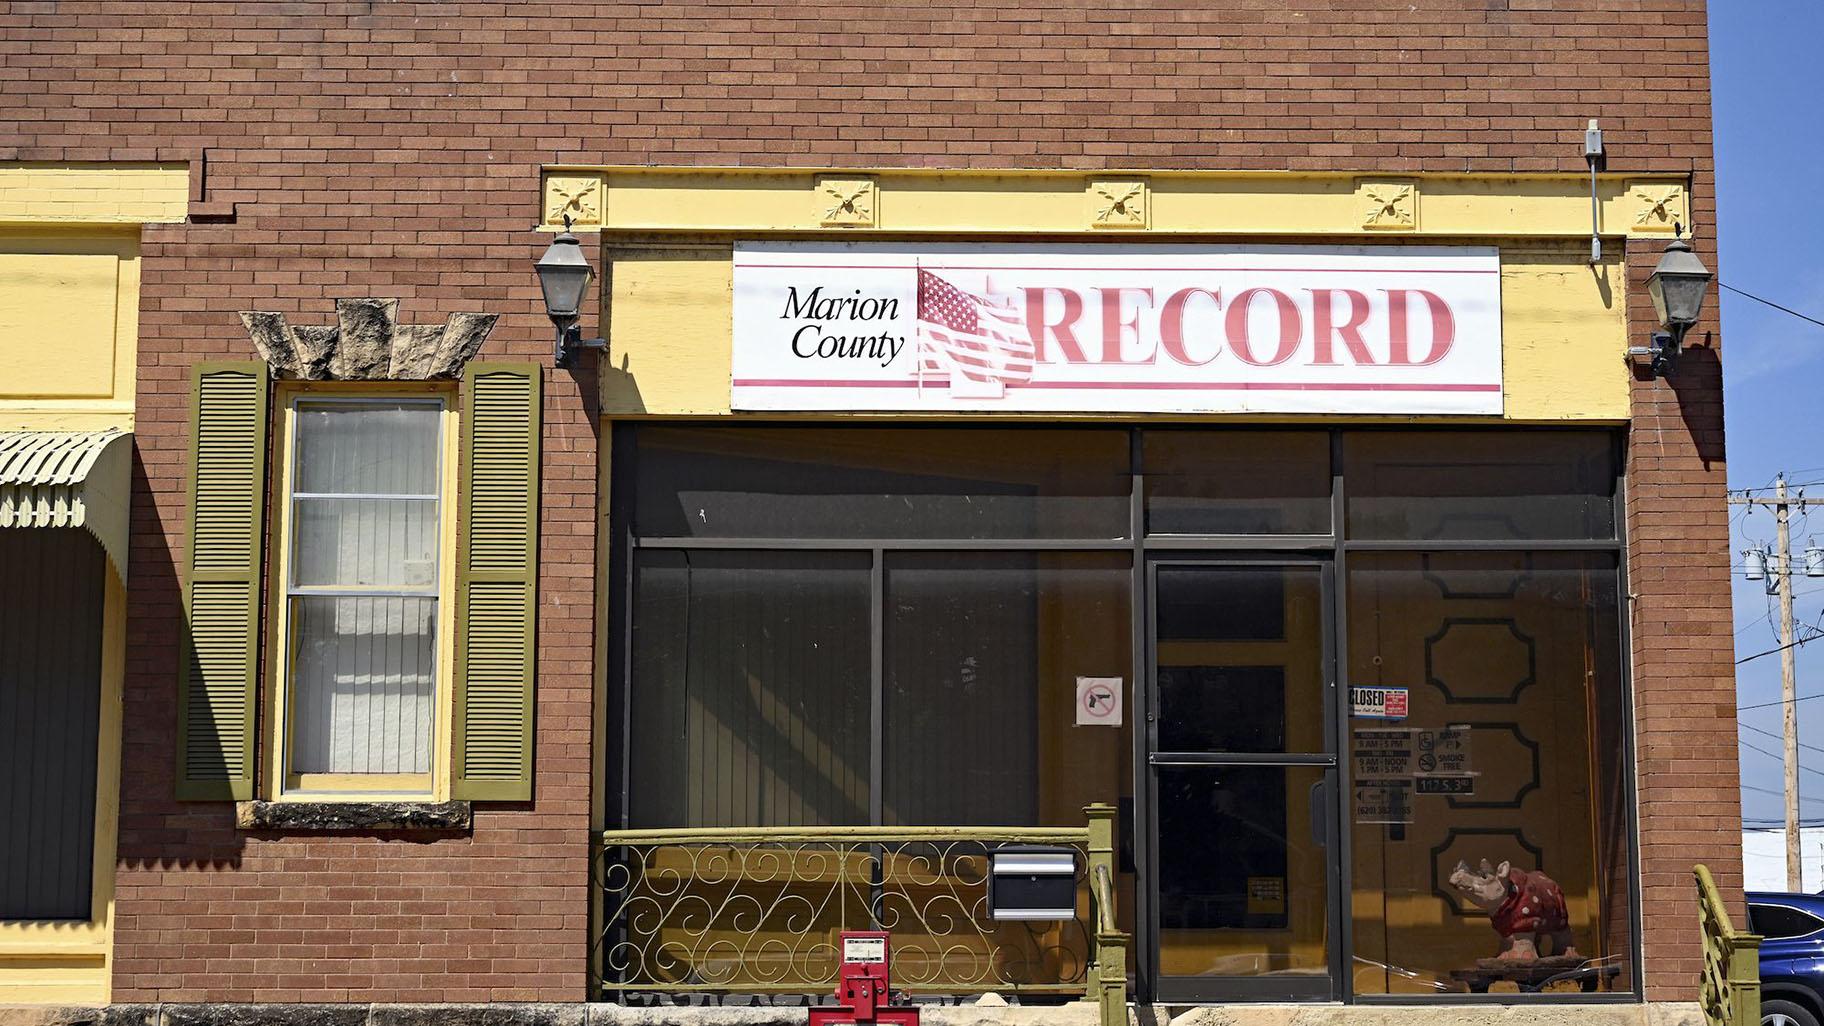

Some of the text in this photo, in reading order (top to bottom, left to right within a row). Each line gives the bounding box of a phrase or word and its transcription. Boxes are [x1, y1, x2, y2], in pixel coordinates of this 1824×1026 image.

[780, 286, 898, 321] Marion
[1017, 286, 1456, 366] RECORD
[792, 325, 904, 367] County
[1349, 687, 1385, 706] CLOSED
[1365, 740, 1378, 749] AM
[1390, 740, 1404, 749] PM
[1365, 758, 1378, 766] AM
[1384, 758, 1408, 766] NOON
[1438, 753, 1465, 762] SMOKE
[1366, 766, 1379, 774] PM
[1390, 766, 1404, 774] PM
[1443, 762, 1462, 770] FREE
